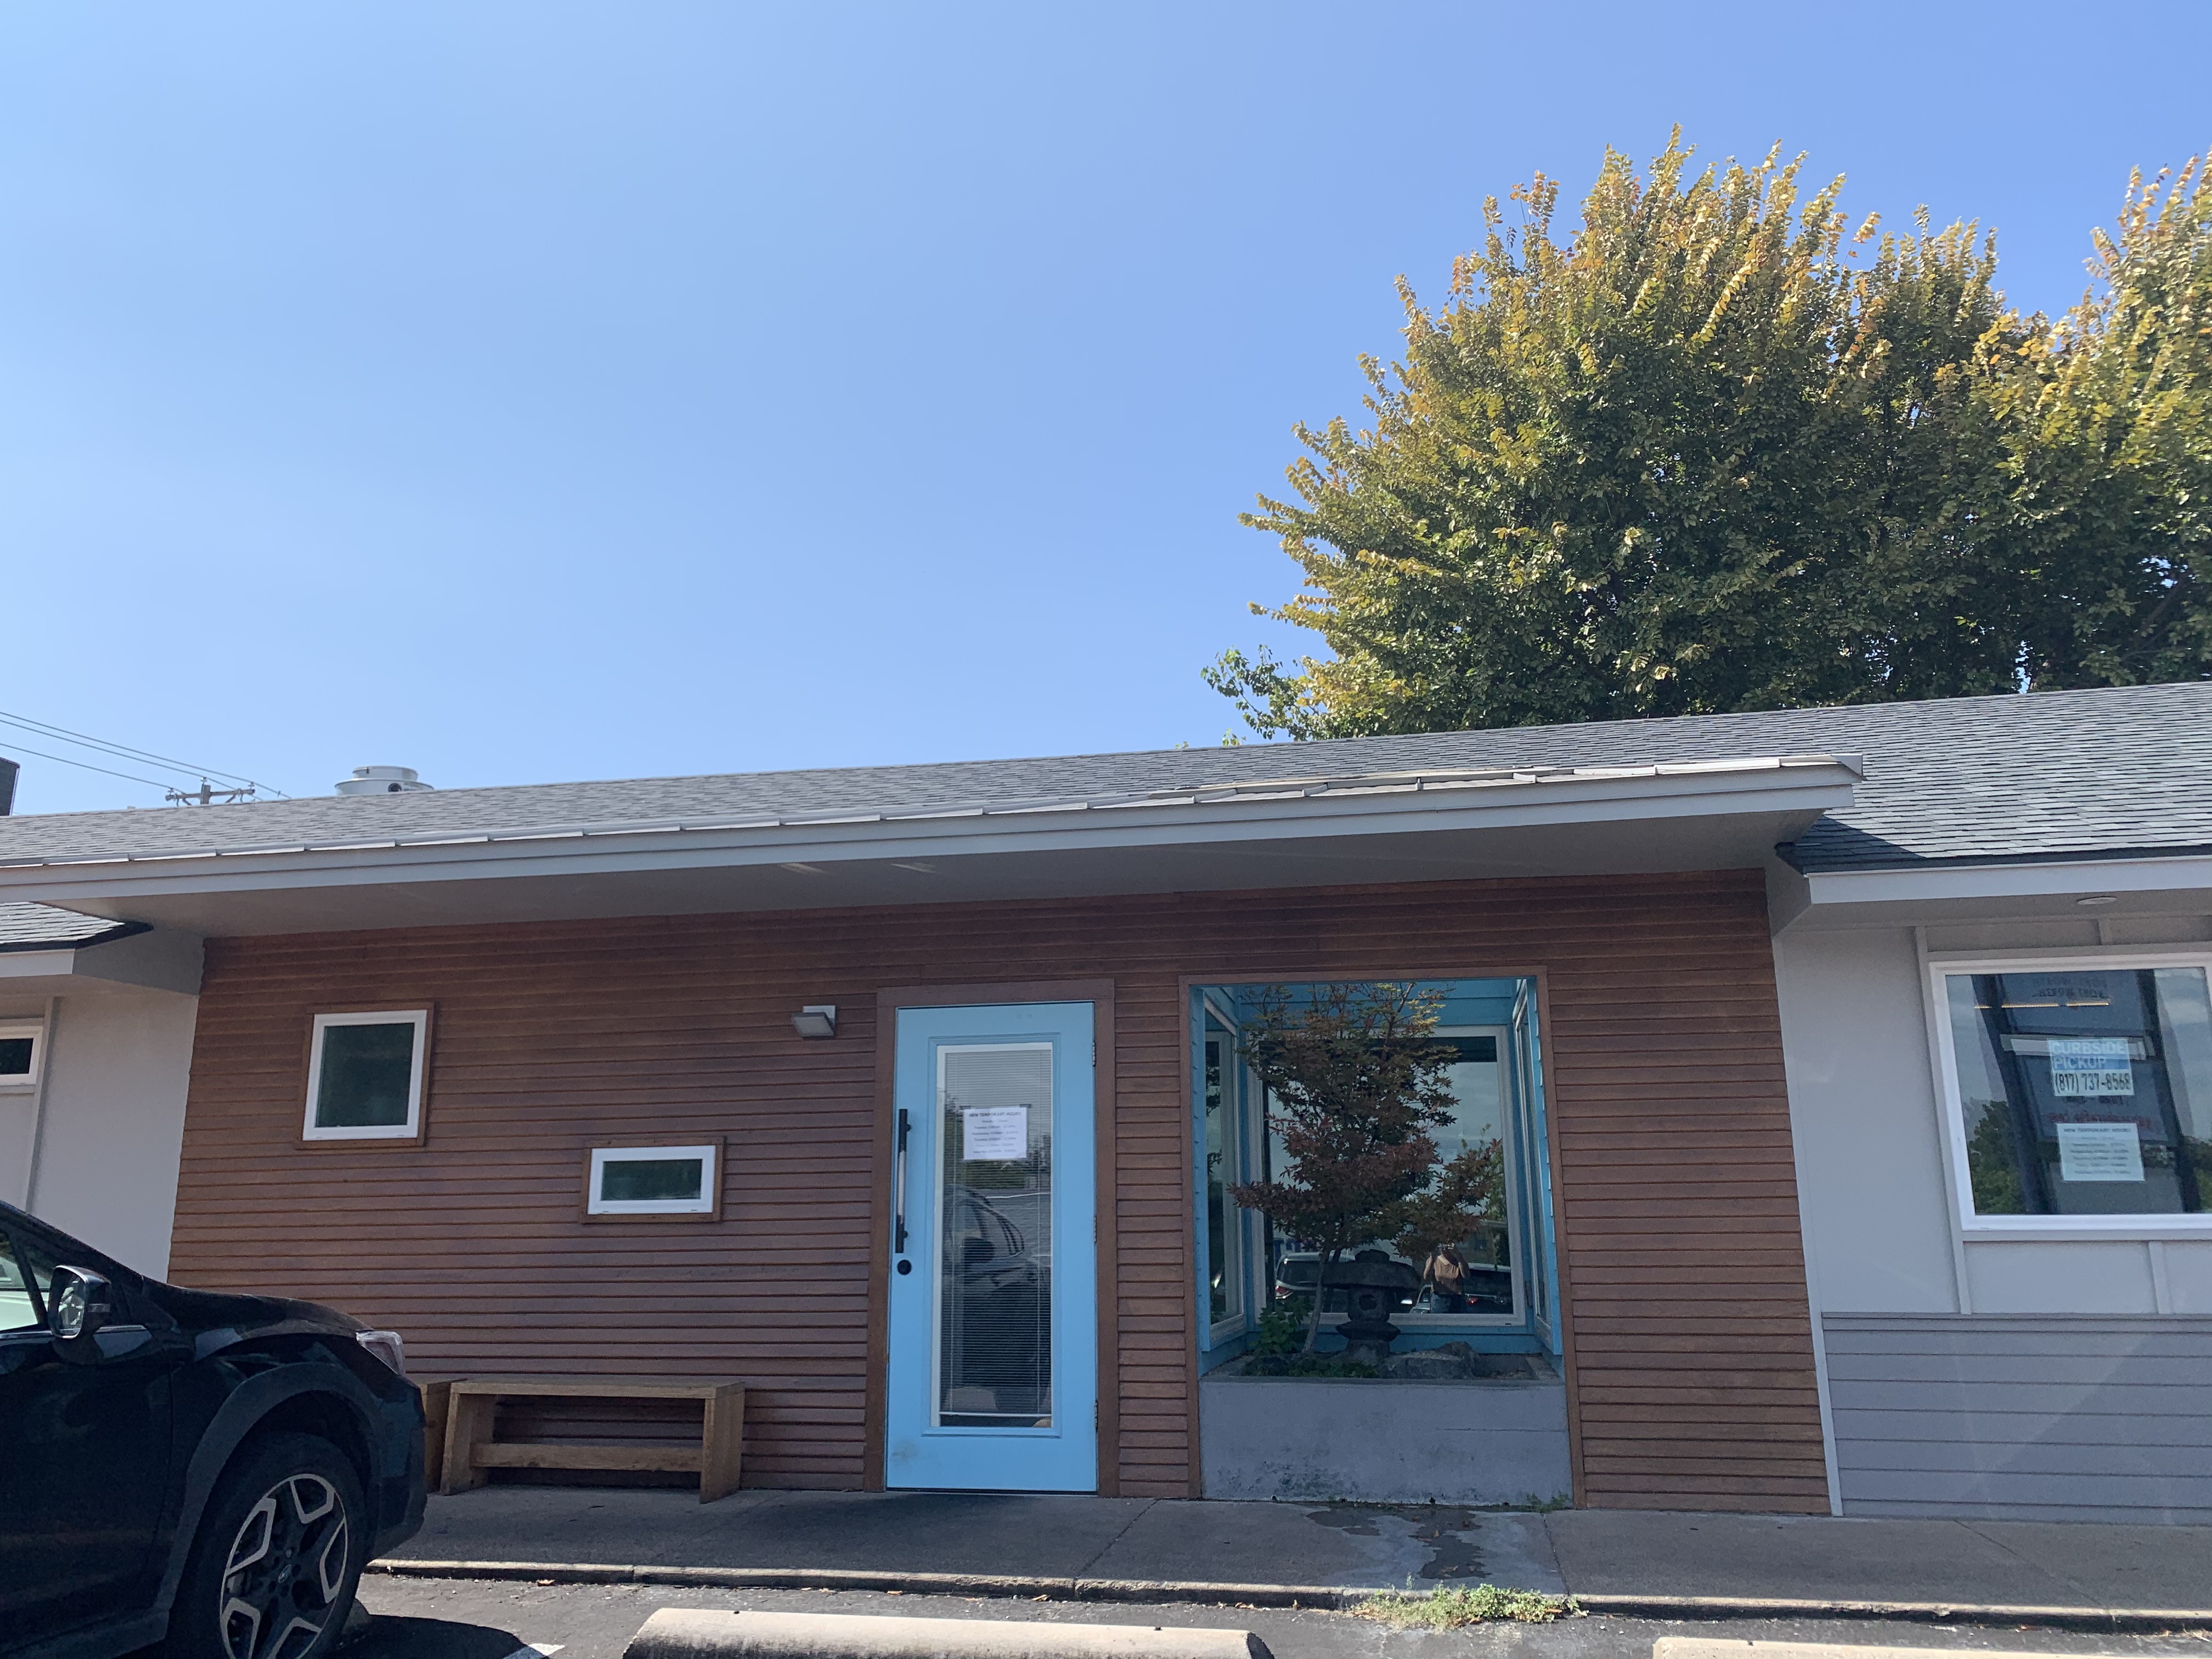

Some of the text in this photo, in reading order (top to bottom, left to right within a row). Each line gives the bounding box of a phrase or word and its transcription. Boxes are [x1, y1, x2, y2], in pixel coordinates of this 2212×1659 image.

[2052, 1042, 2125, 1054] CURBSIDE
[2053, 1056, 2107, 1069] PICKUP
[2055, 1073, 2079, 1093] (817)
